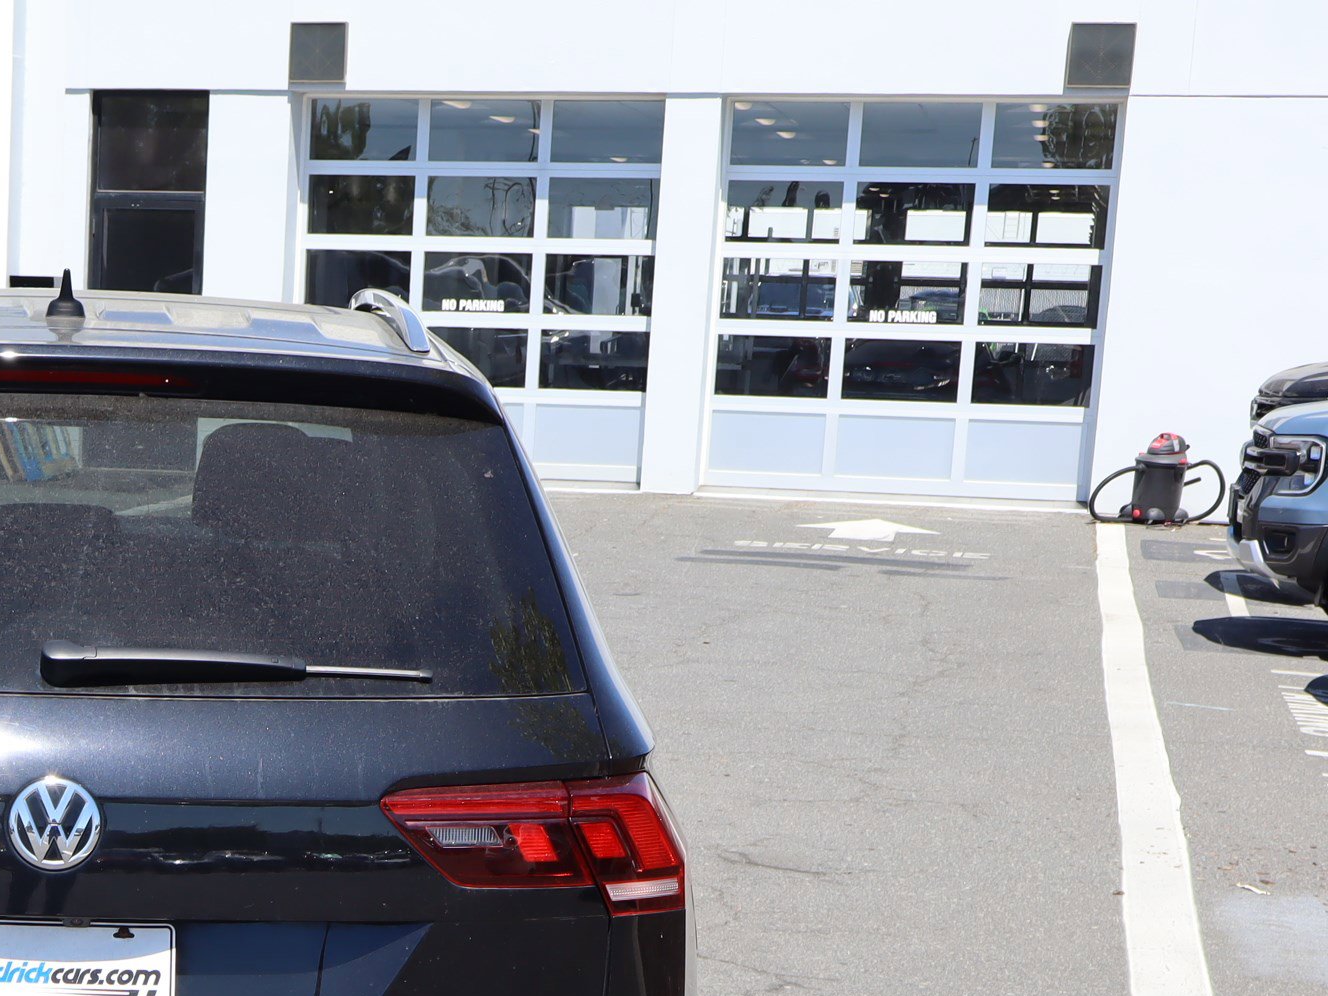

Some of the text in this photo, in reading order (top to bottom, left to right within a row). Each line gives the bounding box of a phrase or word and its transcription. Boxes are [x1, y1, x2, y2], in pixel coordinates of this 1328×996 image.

[441, 298, 505, 312] NO PARKING
[869, 309, 937, 324] NO PARKING
[733, 540, 992, 560] SERVICE
